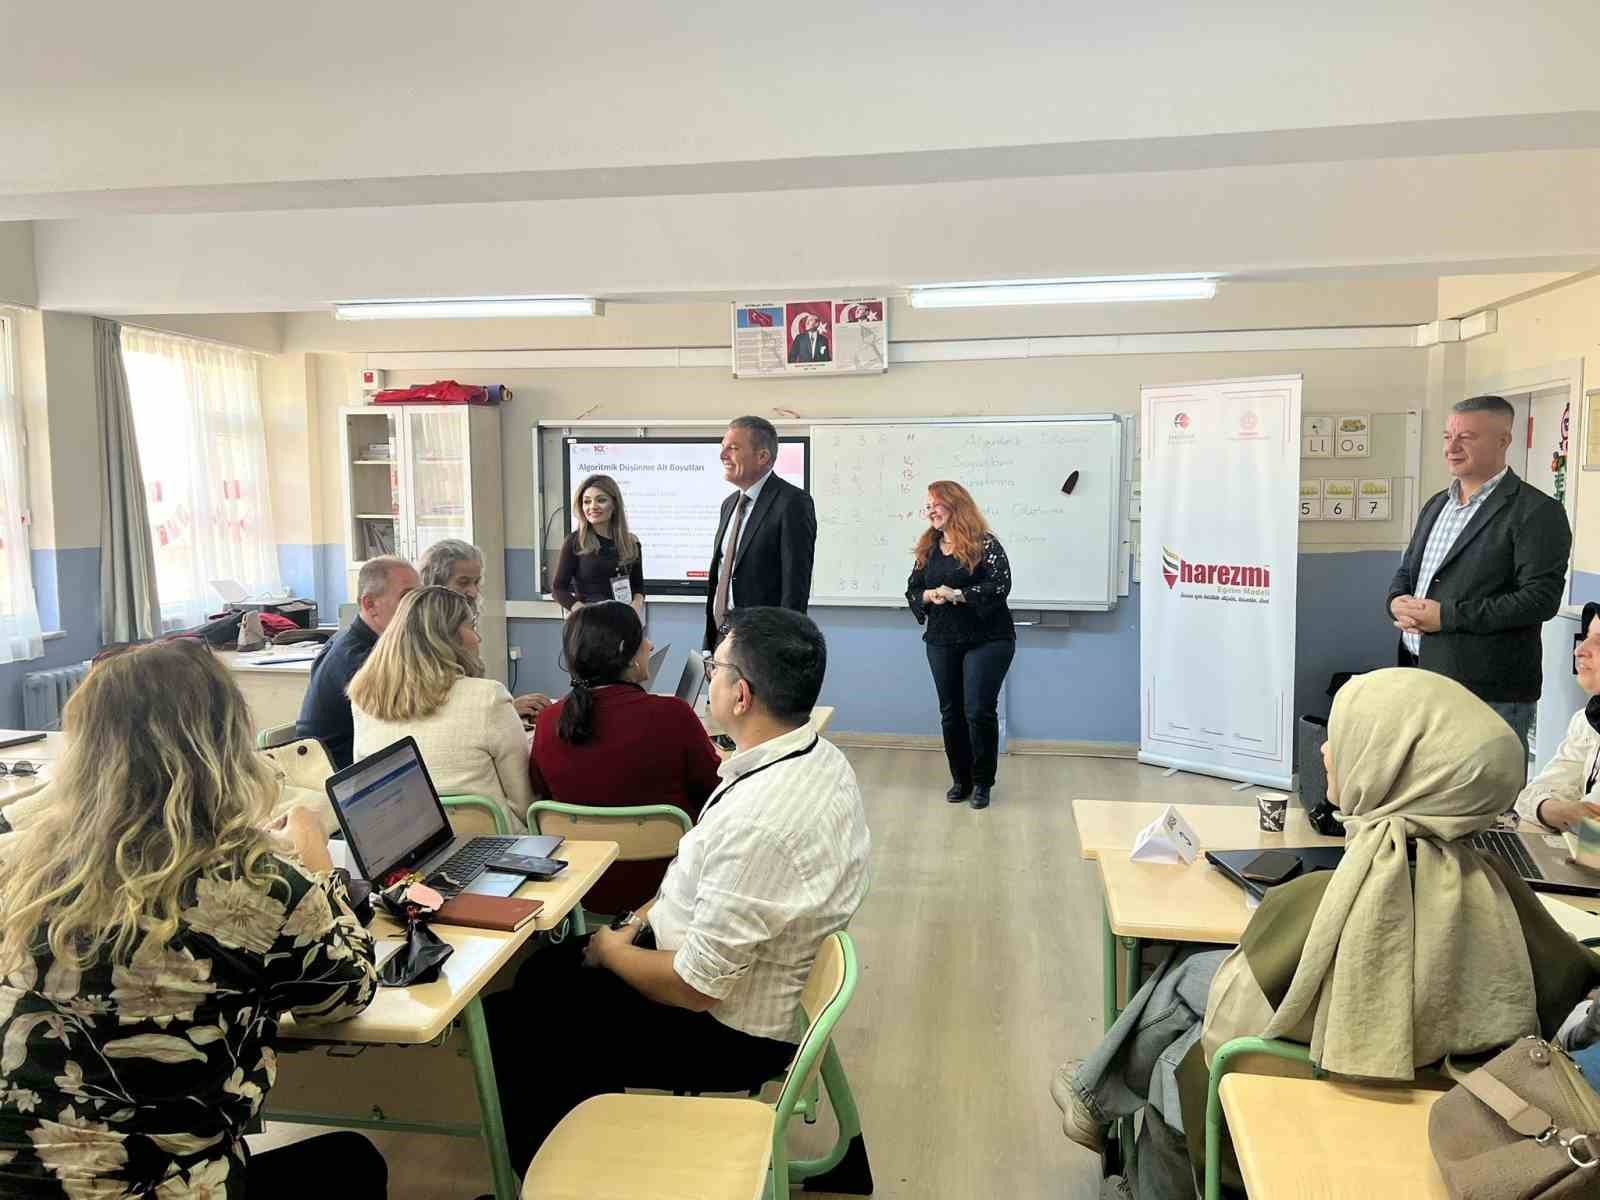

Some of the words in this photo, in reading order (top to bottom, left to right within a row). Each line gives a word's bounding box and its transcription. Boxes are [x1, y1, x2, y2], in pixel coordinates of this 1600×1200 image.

[579, 463, 618, 473] Algoritmik
[657, 463, 668, 473] Alt
[669, 463, 705, 473] Boyutları
[1301, 502, 1311, 515] 5
[1334, 502, 1343, 515] 6
[1368, 501, 1378, 515] 7
[1180, 559, 1270, 588] harezmi
